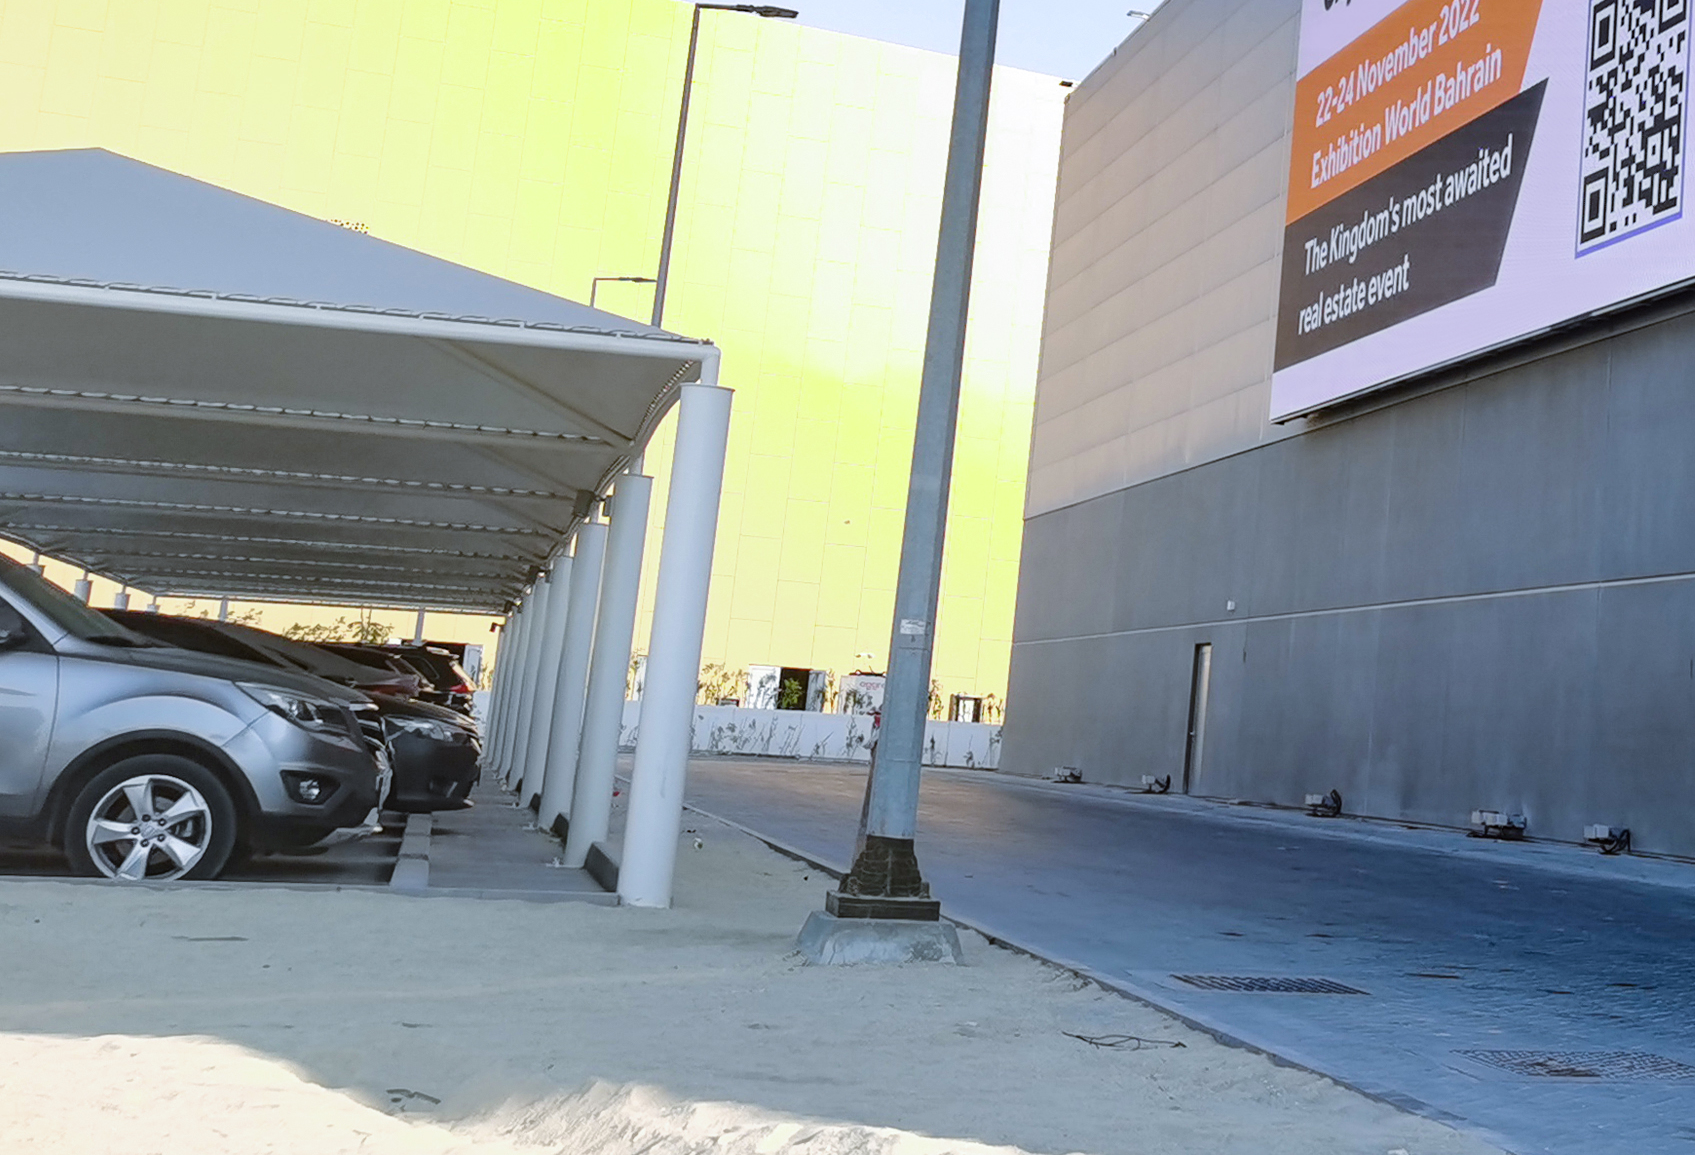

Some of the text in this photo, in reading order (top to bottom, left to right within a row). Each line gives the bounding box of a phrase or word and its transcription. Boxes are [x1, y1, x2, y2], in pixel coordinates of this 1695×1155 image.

[1310, 43, 1502, 189] Exhibition World Bahrain
[1315, 70, 1355, 128] 22-24
[1356, 21, 1438, 100] November
[1304, 133, 1513, 277] The Kingdom's most awaited
[1298, 253, 1410, 335] real estate event
